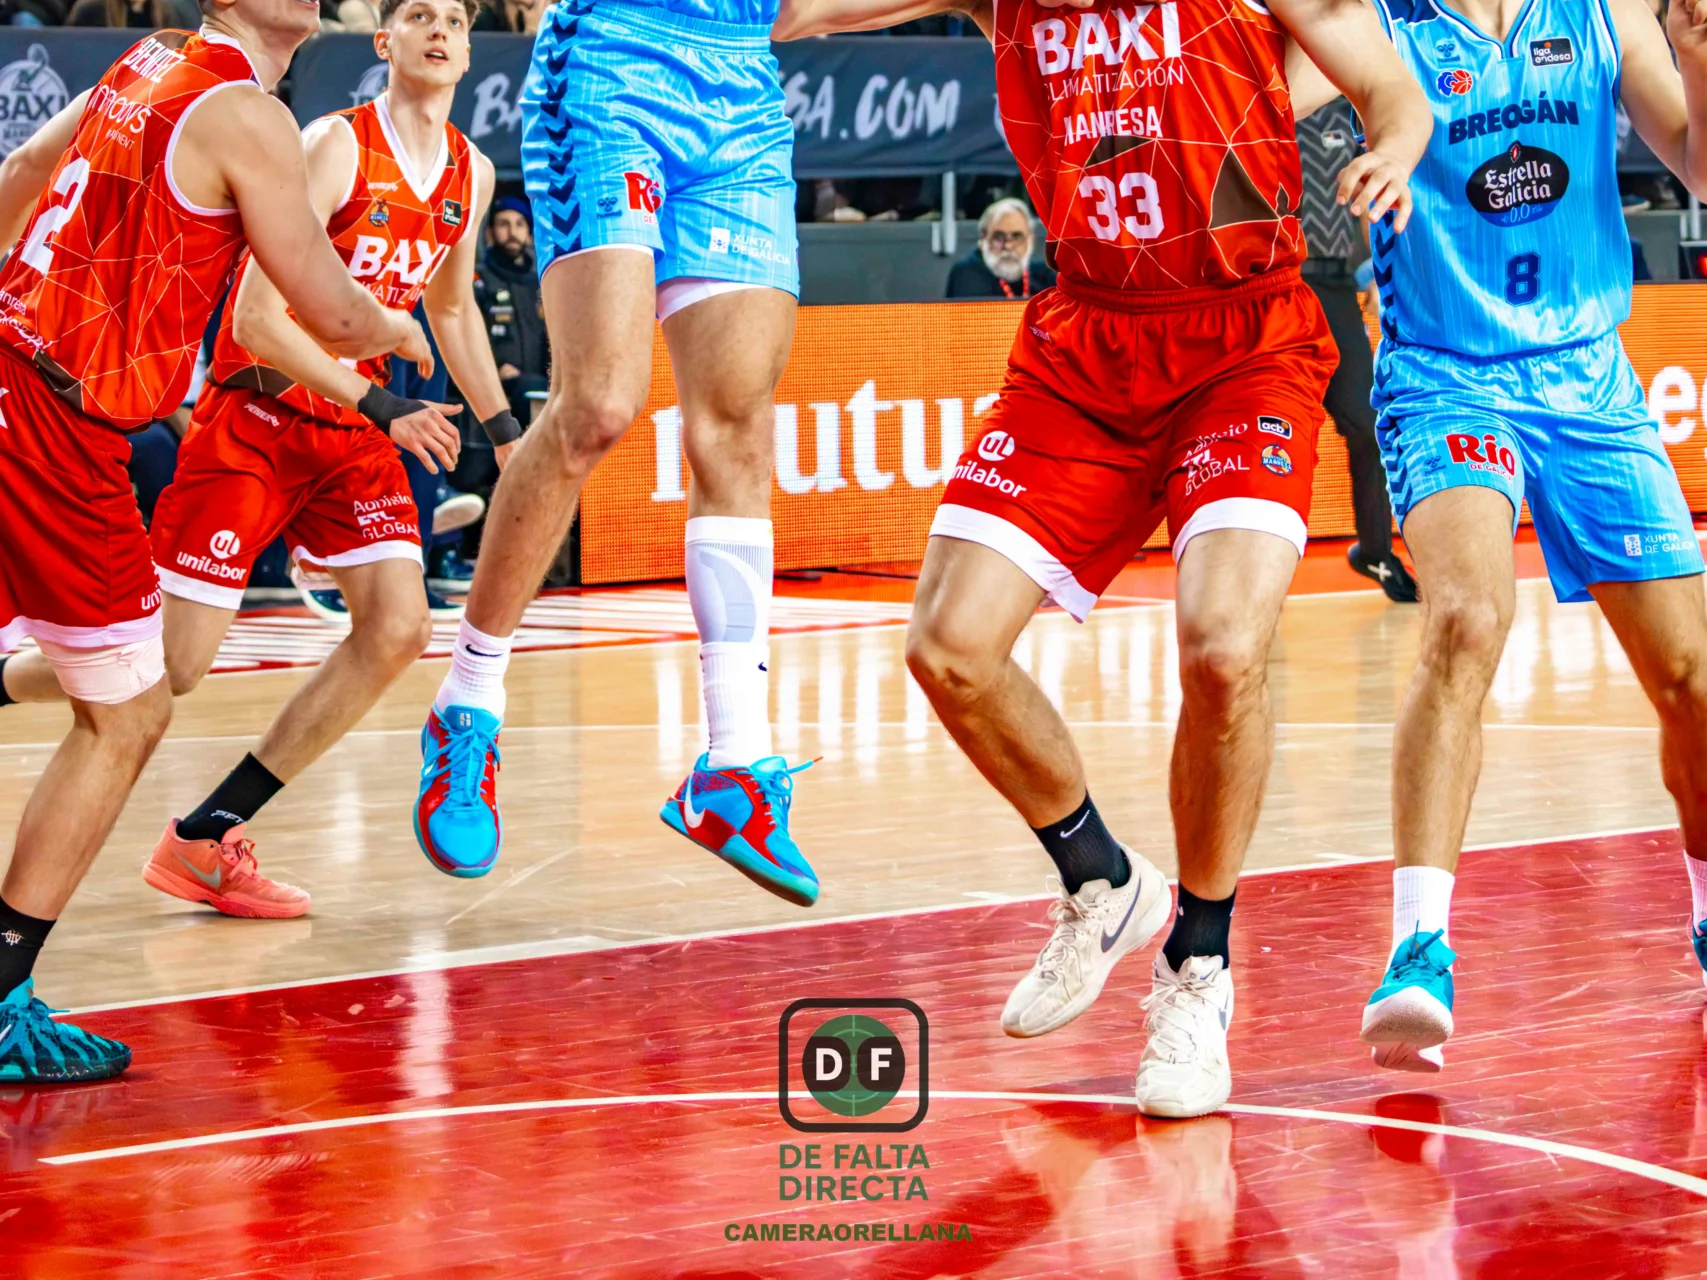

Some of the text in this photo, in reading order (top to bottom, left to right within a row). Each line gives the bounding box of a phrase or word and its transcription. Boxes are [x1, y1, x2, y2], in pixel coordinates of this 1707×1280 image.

[1031, 2, 1182, 76] BAXI
[1533, 47, 1551, 56] liga
[1534, 53, 1572, 63] endesa
[1448, 91, 1579, 145] BREOGÁN
[1484, 160, 1553, 190] Estrella
[1078, 172, 1165, 241] 33
[1488, 181, 1552, 210] Galicia
[20, 157, 91, 276] 2
[734, 233, 773, 250] XUNTA
[1505, 251, 1541, 308] 8
[651, 379, 1001, 502] utu
[1262, 422, 1284, 434] acb
[953, 460, 1027, 498] nilabor
[1185, 455, 1250, 496] GLOBAL
[1644, 532, 1680, 544] XUNTA
[1645, 545, 1659, 554] DE
[176, 551, 247, 582] unilabor
